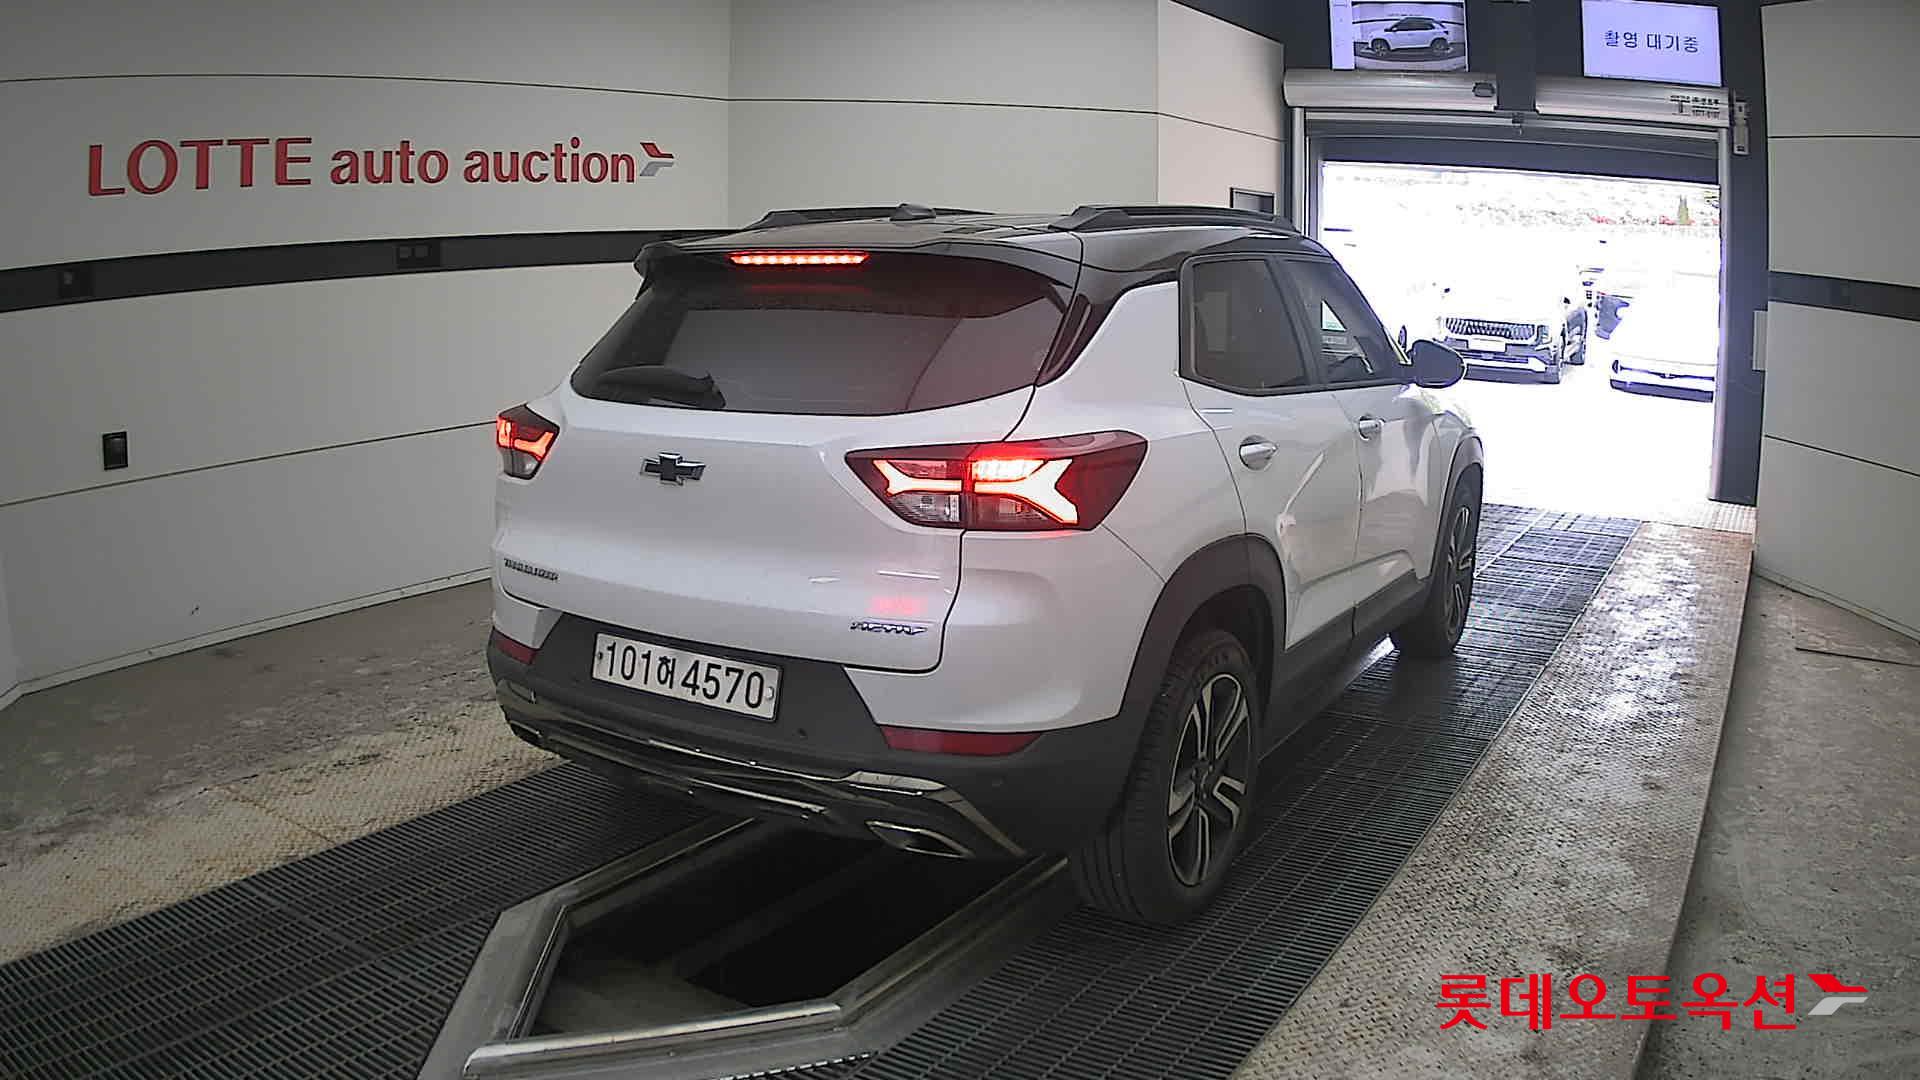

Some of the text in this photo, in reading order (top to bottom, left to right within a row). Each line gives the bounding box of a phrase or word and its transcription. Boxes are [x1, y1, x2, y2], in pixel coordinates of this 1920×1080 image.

[1604, 30, 1699, 53] 촬영 대기중
[88, 136, 637, 197] LOTTE auto auction
